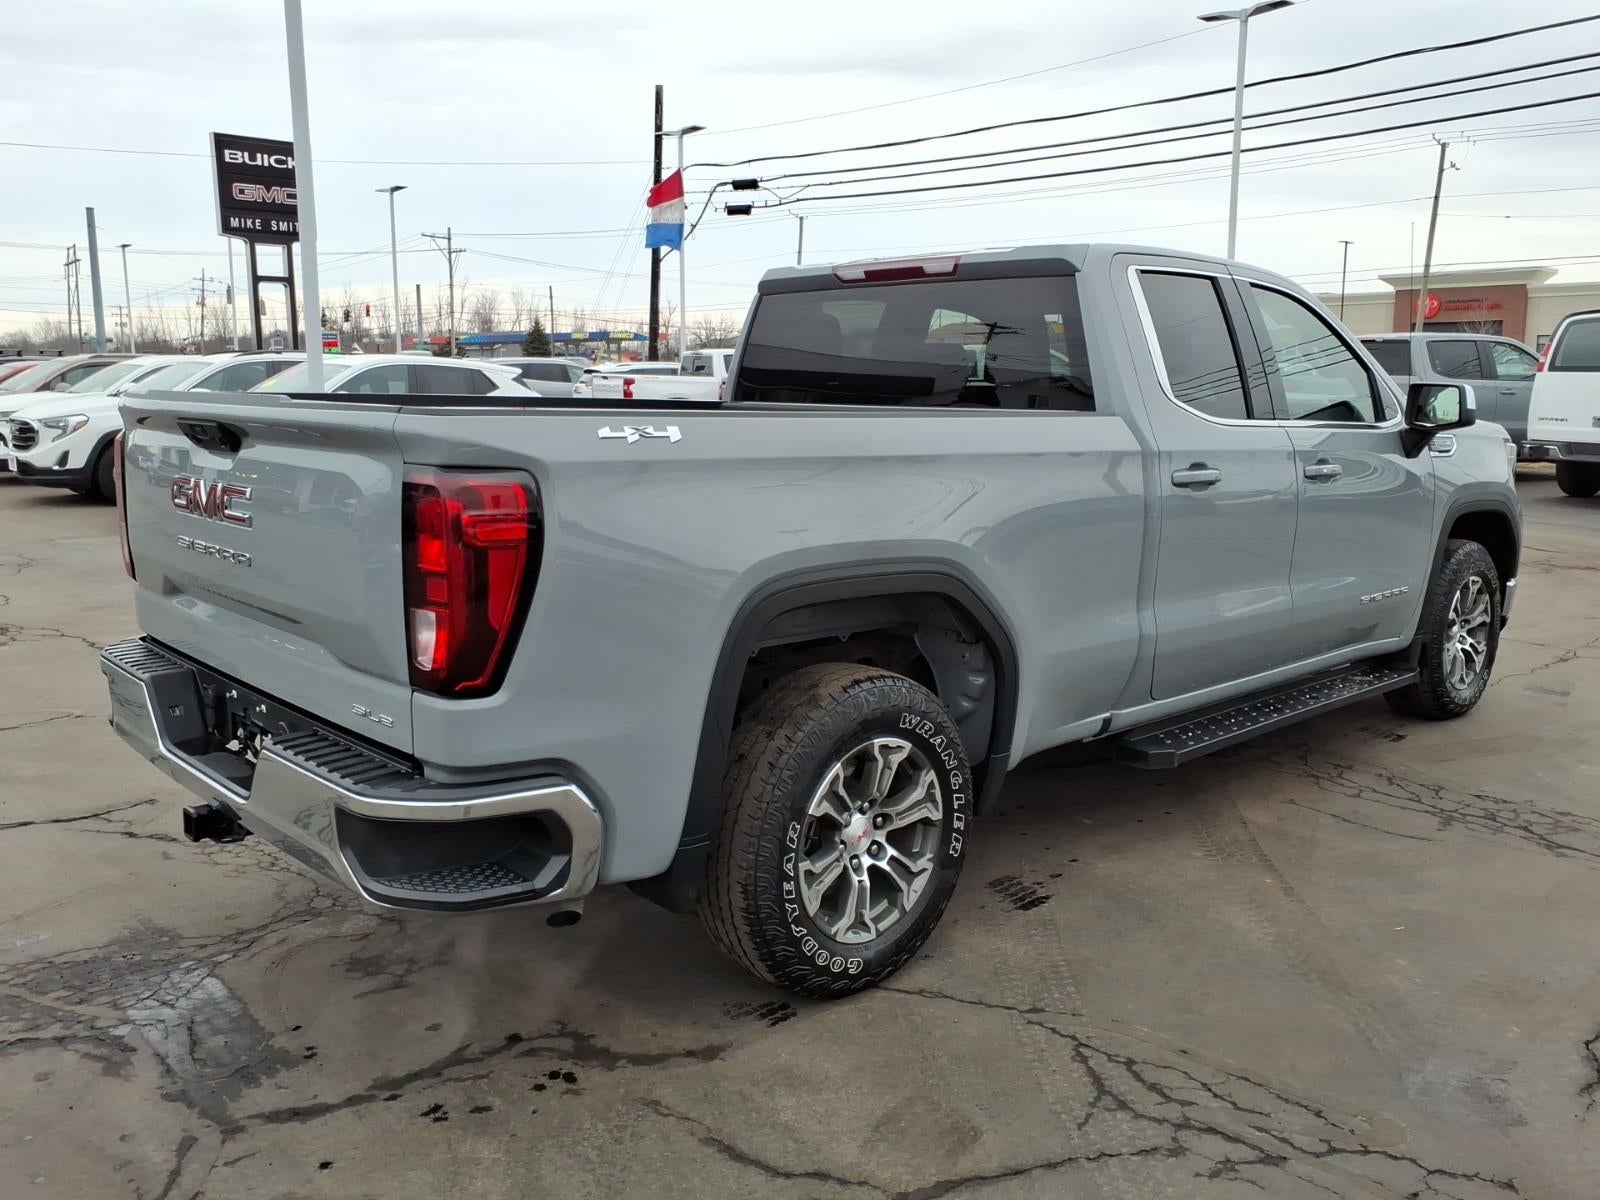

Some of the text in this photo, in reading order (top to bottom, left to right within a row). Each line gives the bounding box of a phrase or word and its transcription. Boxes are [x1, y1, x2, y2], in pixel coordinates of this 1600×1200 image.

[232, 182, 298, 205] GMC
[230, 217, 300, 233] MIKE SMIT
[171, 474, 253, 529] GMC
[177, 535, 252, 568] SIERRA
[899, 712, 966, 858] WRANGLER
[783, 821, 864, 974] GOODYEAR
